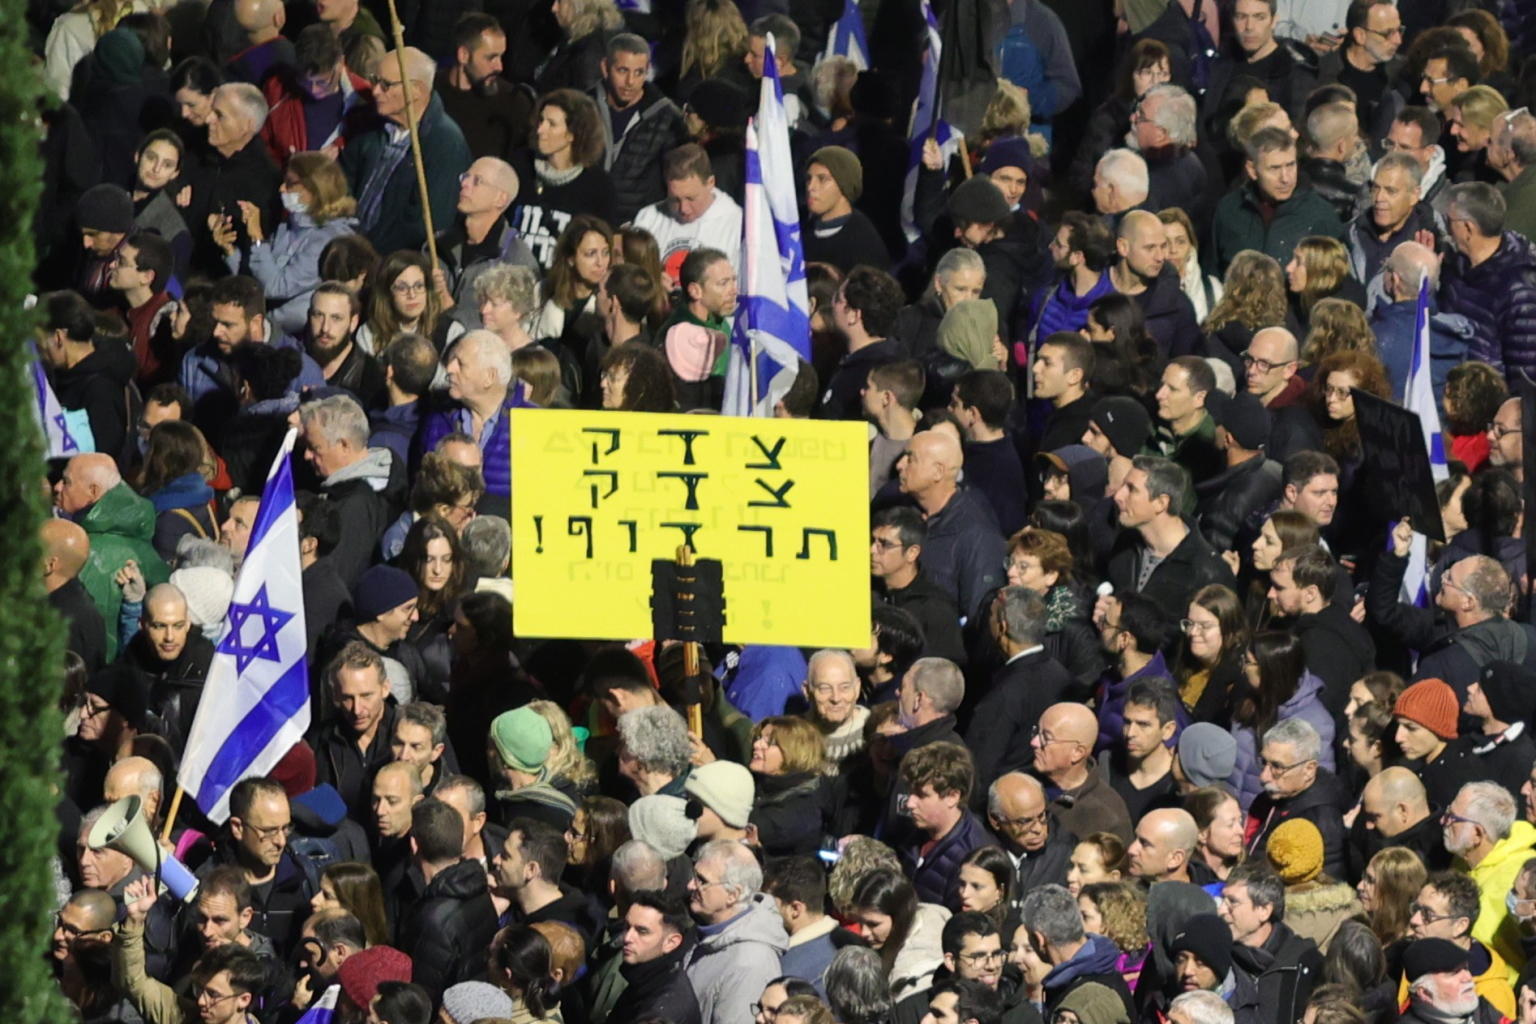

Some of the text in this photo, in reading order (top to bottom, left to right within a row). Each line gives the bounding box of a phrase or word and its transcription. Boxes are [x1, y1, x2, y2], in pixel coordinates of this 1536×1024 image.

[581, 427, 787, 470] צדק
[583, 469, 795, 510] צדק
[533, 515, 838, 561] תרדוף!
